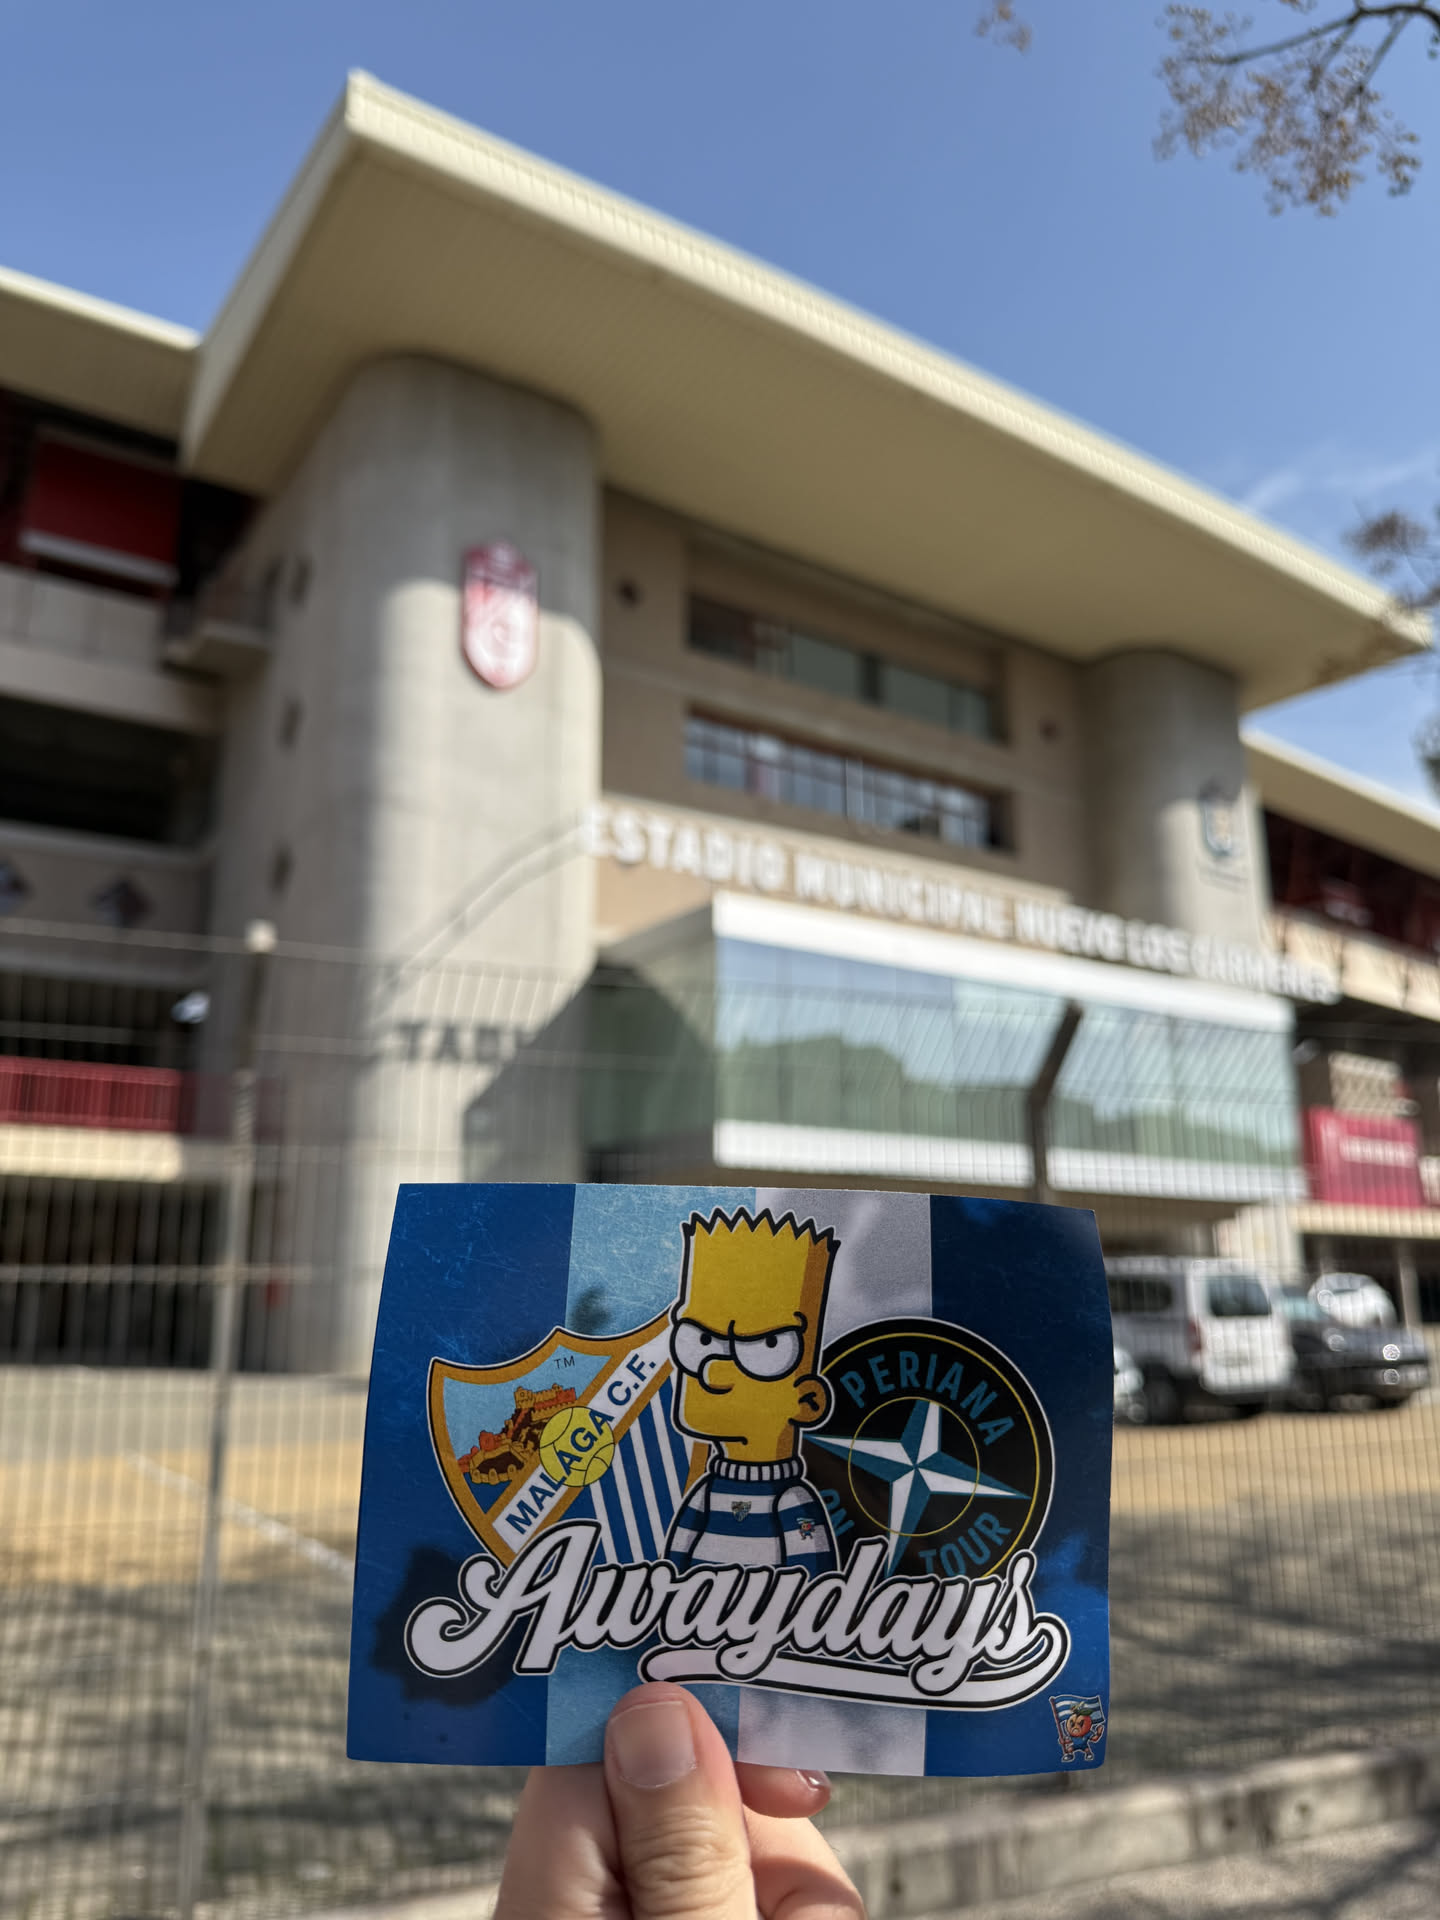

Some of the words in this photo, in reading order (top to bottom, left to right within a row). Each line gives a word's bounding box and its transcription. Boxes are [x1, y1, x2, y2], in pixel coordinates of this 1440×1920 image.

[580, 805, 786, 890] ESTADIO
[796, 853, 1009, 938] MUNICIPAL
[1015, 899, 1124, 961] NUEVO
[554, 1355, 575, 1369] TM
[840, 1351, 1015, 1446] PERIANA
[504, 1408, 615, 1535] MALAGA
[607, 1353, 656, 1406] C.F.
[819, 1488, 855, 1537] ON
[918, 1512, 1011, 1576] TOUR
[405, 1519, 1071, 1711] Awaydays
